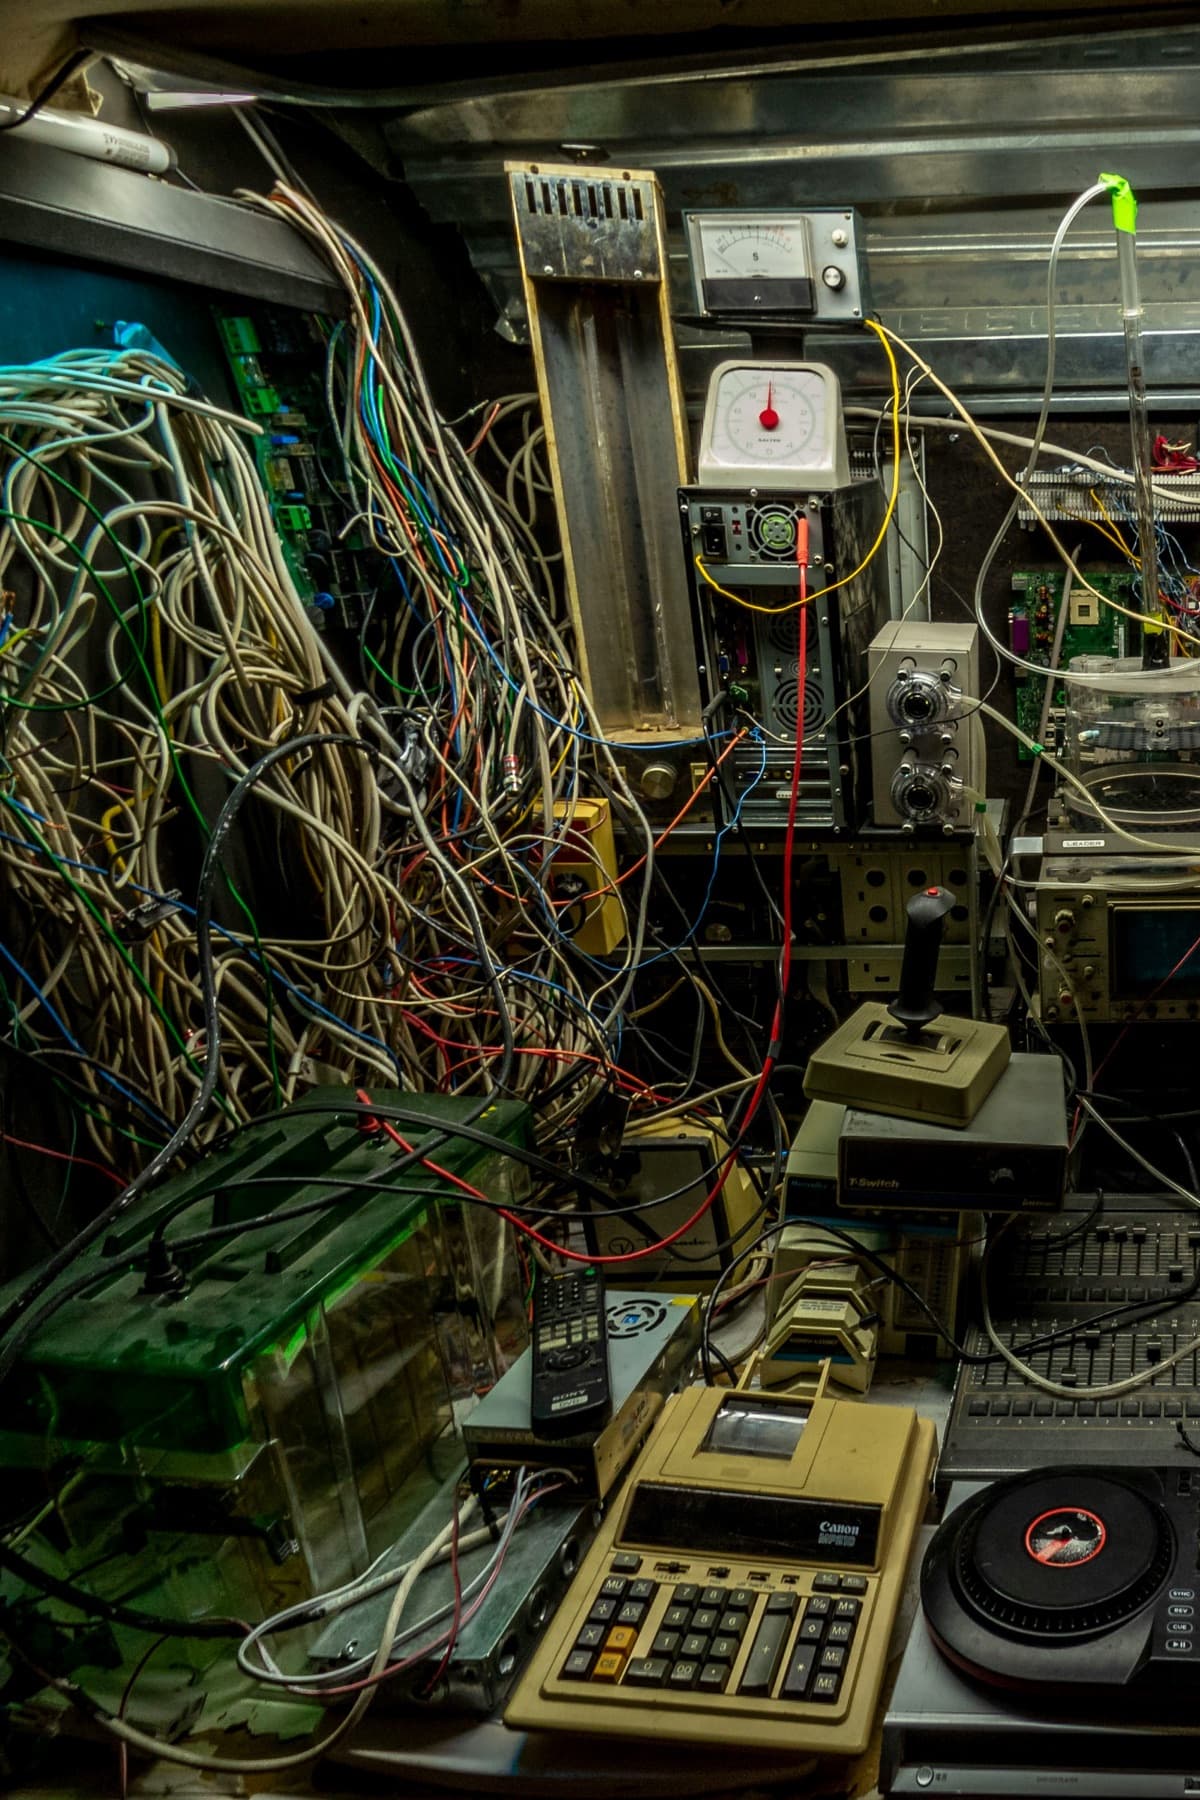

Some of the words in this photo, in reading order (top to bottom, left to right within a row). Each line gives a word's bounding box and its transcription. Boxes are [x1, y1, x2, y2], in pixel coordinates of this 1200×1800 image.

[552, 1388, 586, 1402] SONY
[819, 1520, 860, 1536] Canon
[606, 1580, 623, 1590] MU
[672, 1612, 680, 1621] 4
[728, 1615, 736, 1626] 6
[691, 1639, 699, 1649] 2
[719, 1641, 727, 1651] 3
[676, 1664, 692, 1675] 00
